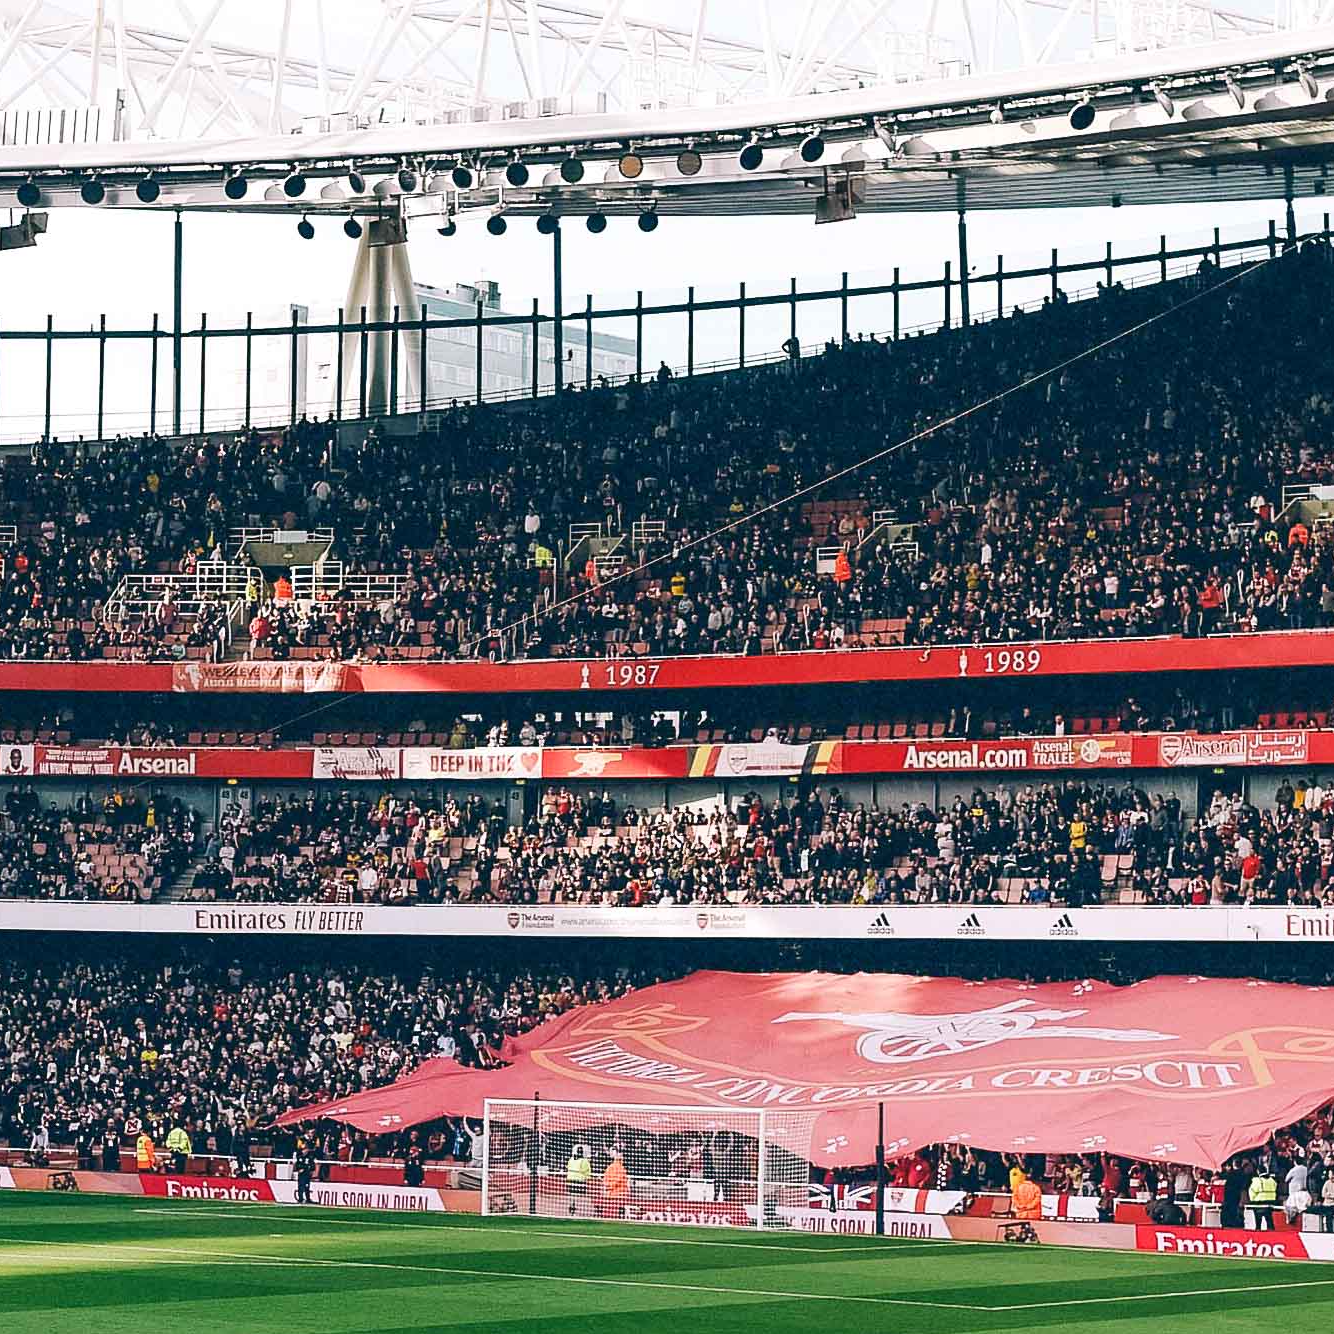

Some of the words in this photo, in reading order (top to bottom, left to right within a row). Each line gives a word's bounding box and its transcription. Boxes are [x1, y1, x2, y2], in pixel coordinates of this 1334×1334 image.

[984, 650, 1040, 673] 1989
[605, 665, 660, 686] 1987
[1032, 739, 1072, 753] Arsenal
[1182, 734, 1246, 757] Arsenal
[118, 752, 196, 774] Arsenal
[430, 755, 464, 772] DEEP
[468, 755, 483, 772] IN
[904, 745, 1027, 768] Arsenal.com
[1033, 752, 1075, 765] TRALEE
[196, 909, 286, 930] Emirates
[294, 911, 317, 930] FLY
[319, 911, 364, 931] BETTER
[867, 926, 895, 935] adidas
[956, 926, 985, 936] adidas
[1049, 926, 1079, 936] adidas
[563, 1040, 708, 1083] VICTORIA
[692, 1075, 975, 1105] CONCORDIA
[991, 1060, 1242, 1089] CRESCIT
[166, 1178, 259, 1202] Emirates
[317, 1190, 338, 1206] YOU
[342, 1192, 374, 1208] SOON
[376, 1194, 390, 1210] IN
[830, 1214, 859, 1234] SOON
[1156, 1231, 1286, 1259] Emirates
